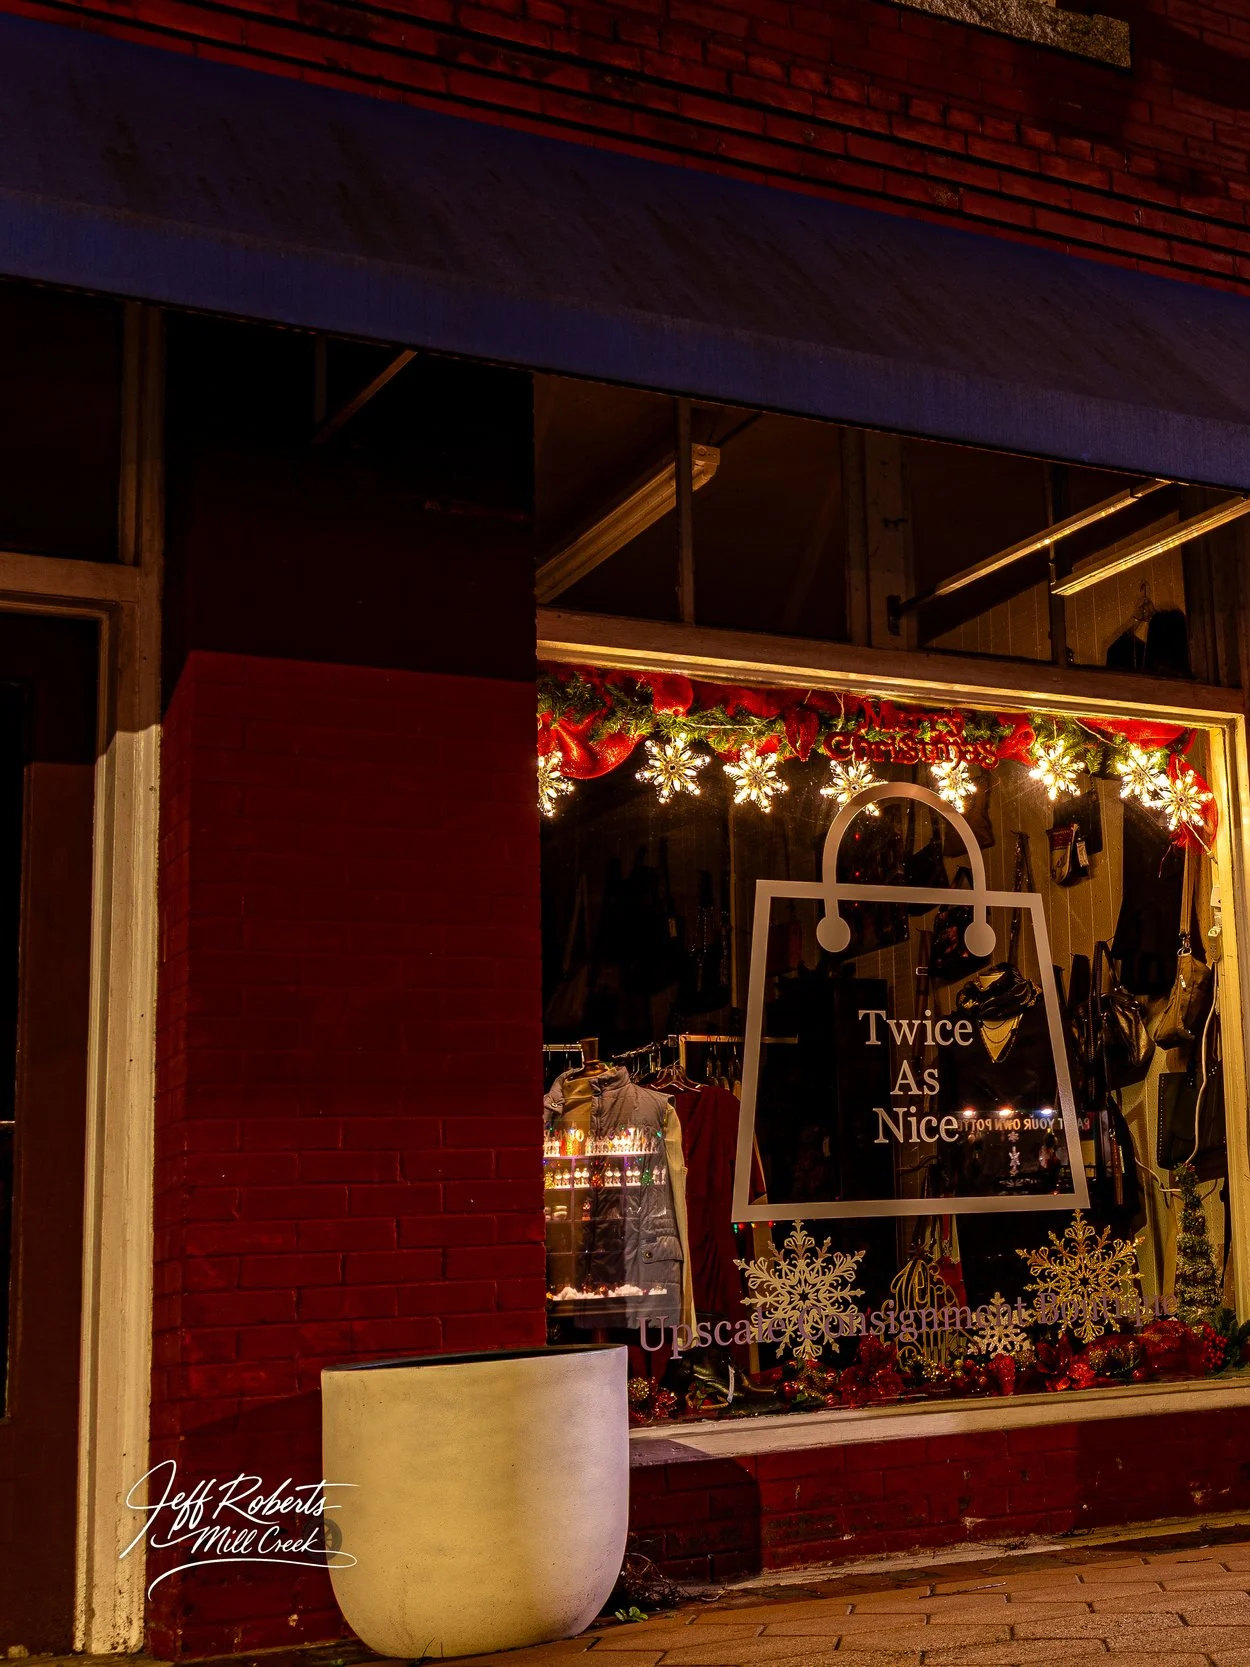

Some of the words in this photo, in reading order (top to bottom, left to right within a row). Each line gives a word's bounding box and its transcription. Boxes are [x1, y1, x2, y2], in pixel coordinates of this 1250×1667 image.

[859, 699, 965, 740] Merry
[823, 731, 1000, 770] Christmas
[858, 1009, 974, 1046] Twice
[890, 1060, 940, 1095] As
[872, 1106, 959, 1144] Nice
[636, 1307, 787, 1360] Upscale
[798, 1296, 1030, 1343] Consignment
[1038, 1286, 1179, 1327] Boutique
